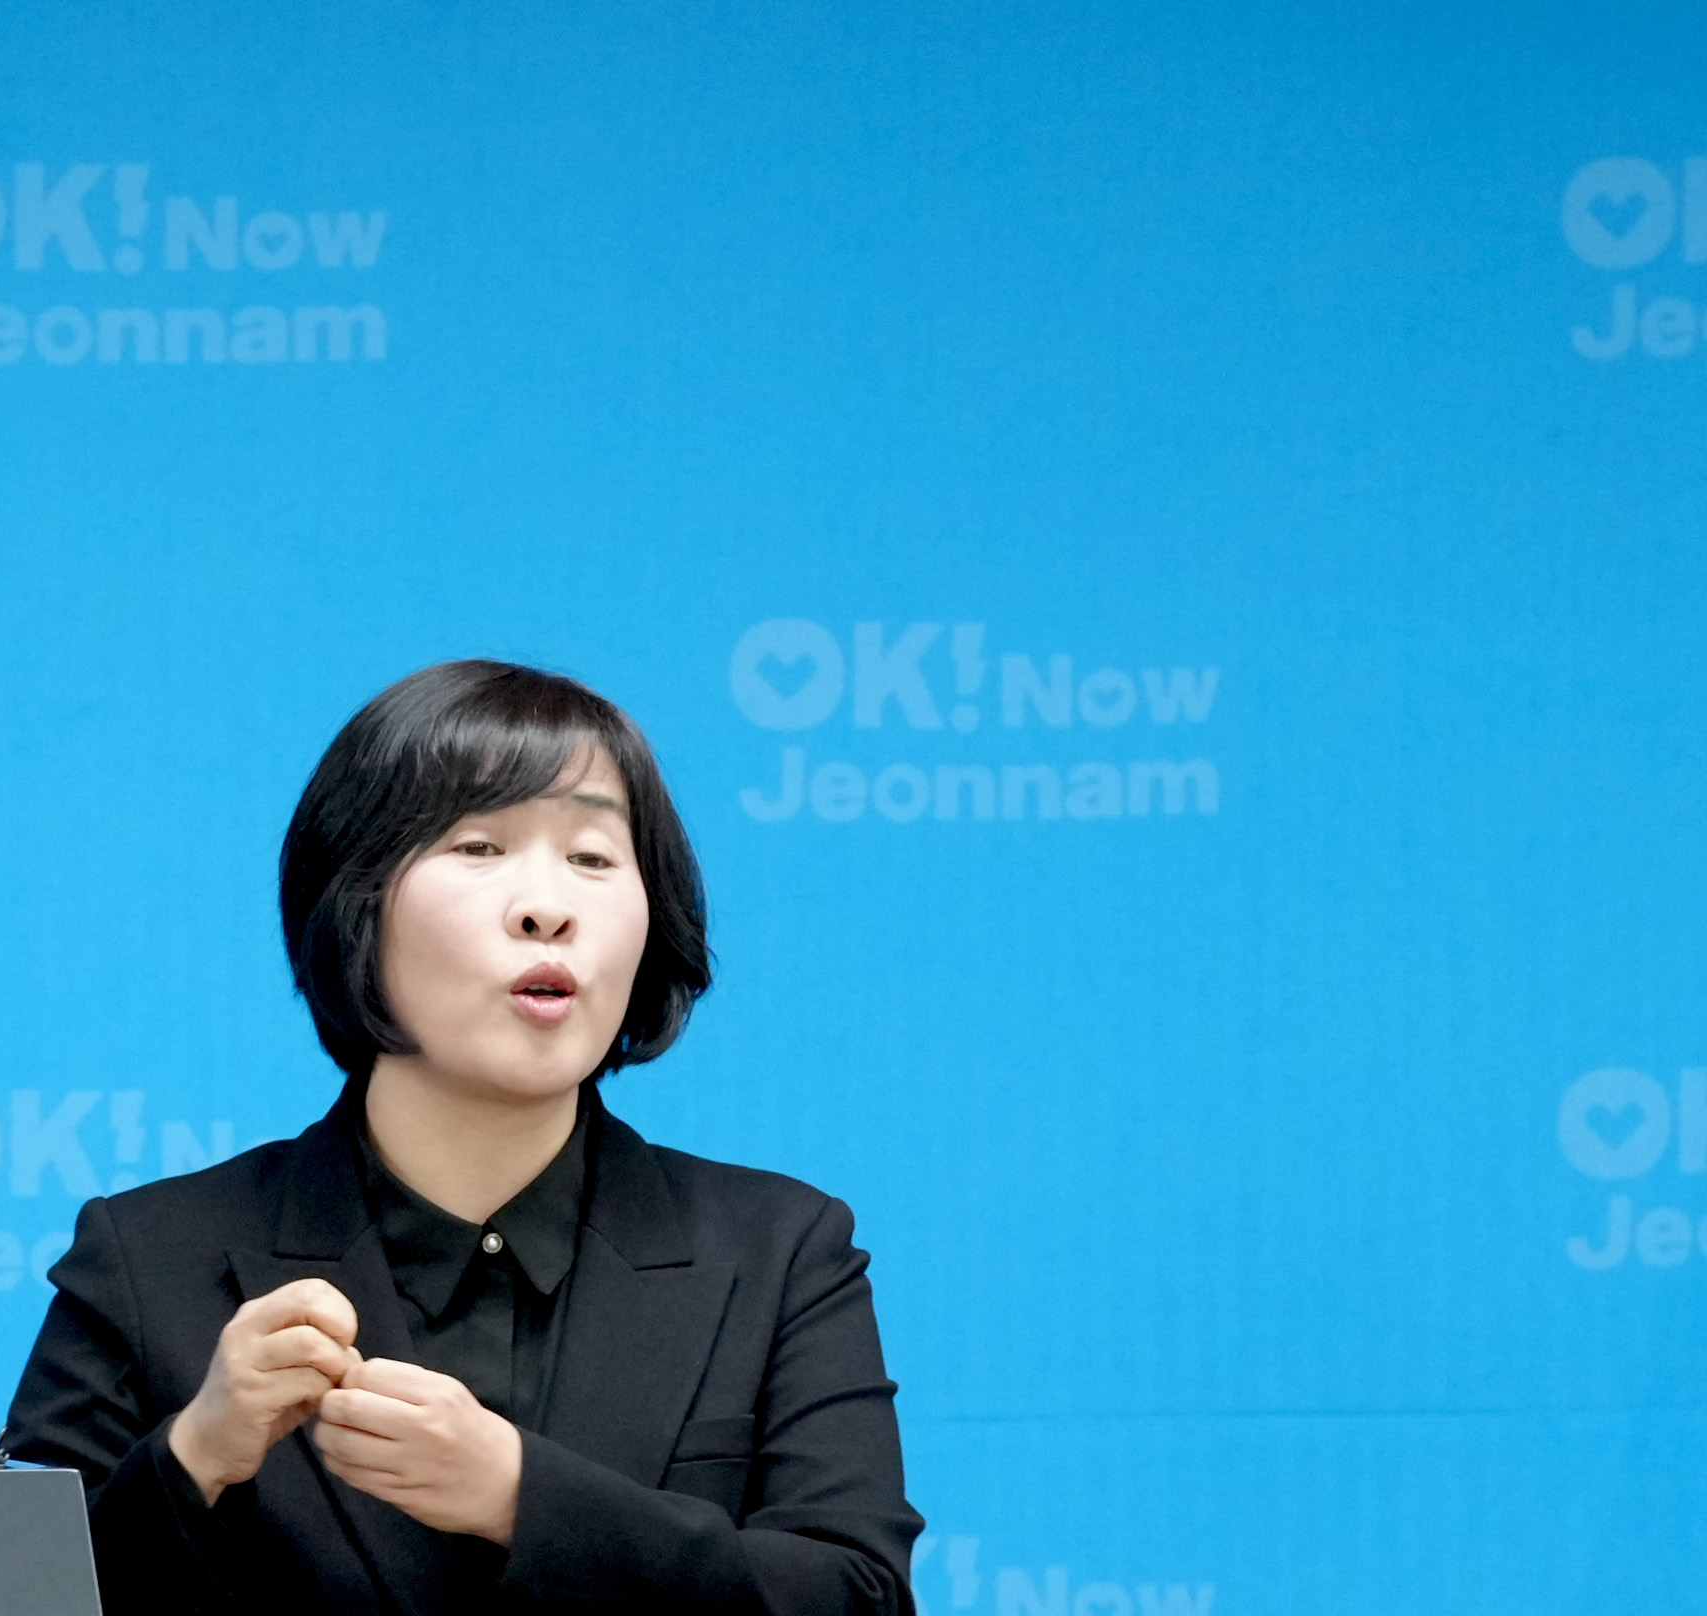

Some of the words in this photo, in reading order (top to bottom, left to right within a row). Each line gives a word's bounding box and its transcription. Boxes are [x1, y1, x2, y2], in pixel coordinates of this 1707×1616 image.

[1571, 284, 1707, 362] Je
[739, 745, 1222, 824] Jeonnam
[1565, 1194, 1707, 1272] Je
